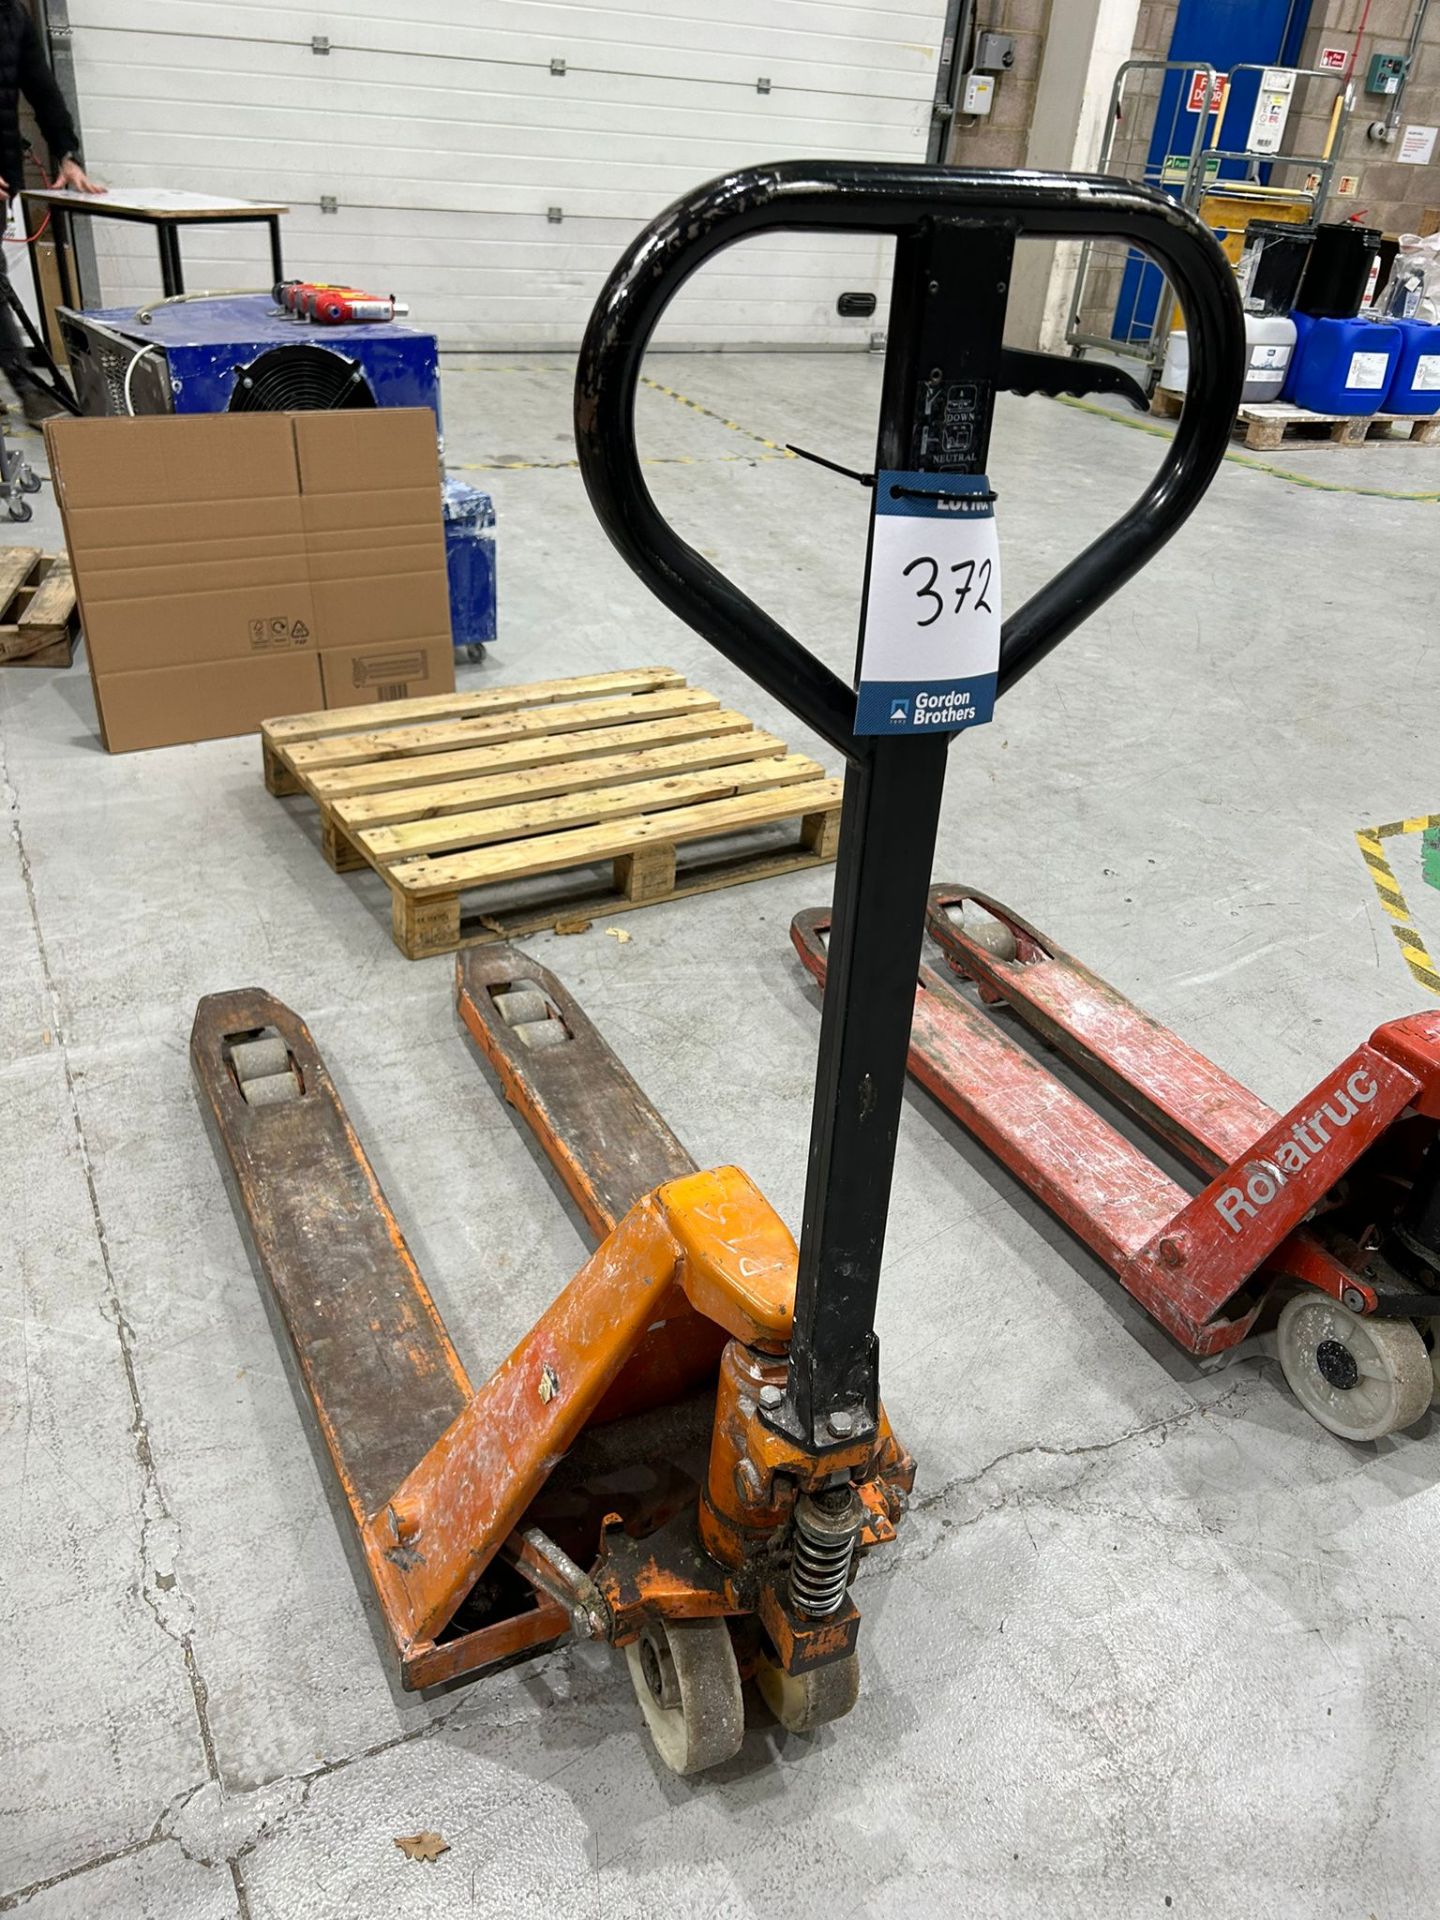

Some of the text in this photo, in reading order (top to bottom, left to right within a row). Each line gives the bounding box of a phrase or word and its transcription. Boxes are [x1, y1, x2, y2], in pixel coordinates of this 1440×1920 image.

[947, 413, 975, 423] DOWN
[932, 452, 977, 464] NEUTRAL
[902, 556, 992, 627] 372
[915, 690, 971, 709] Gordon
[913, 706, 976, 725] Brothers
